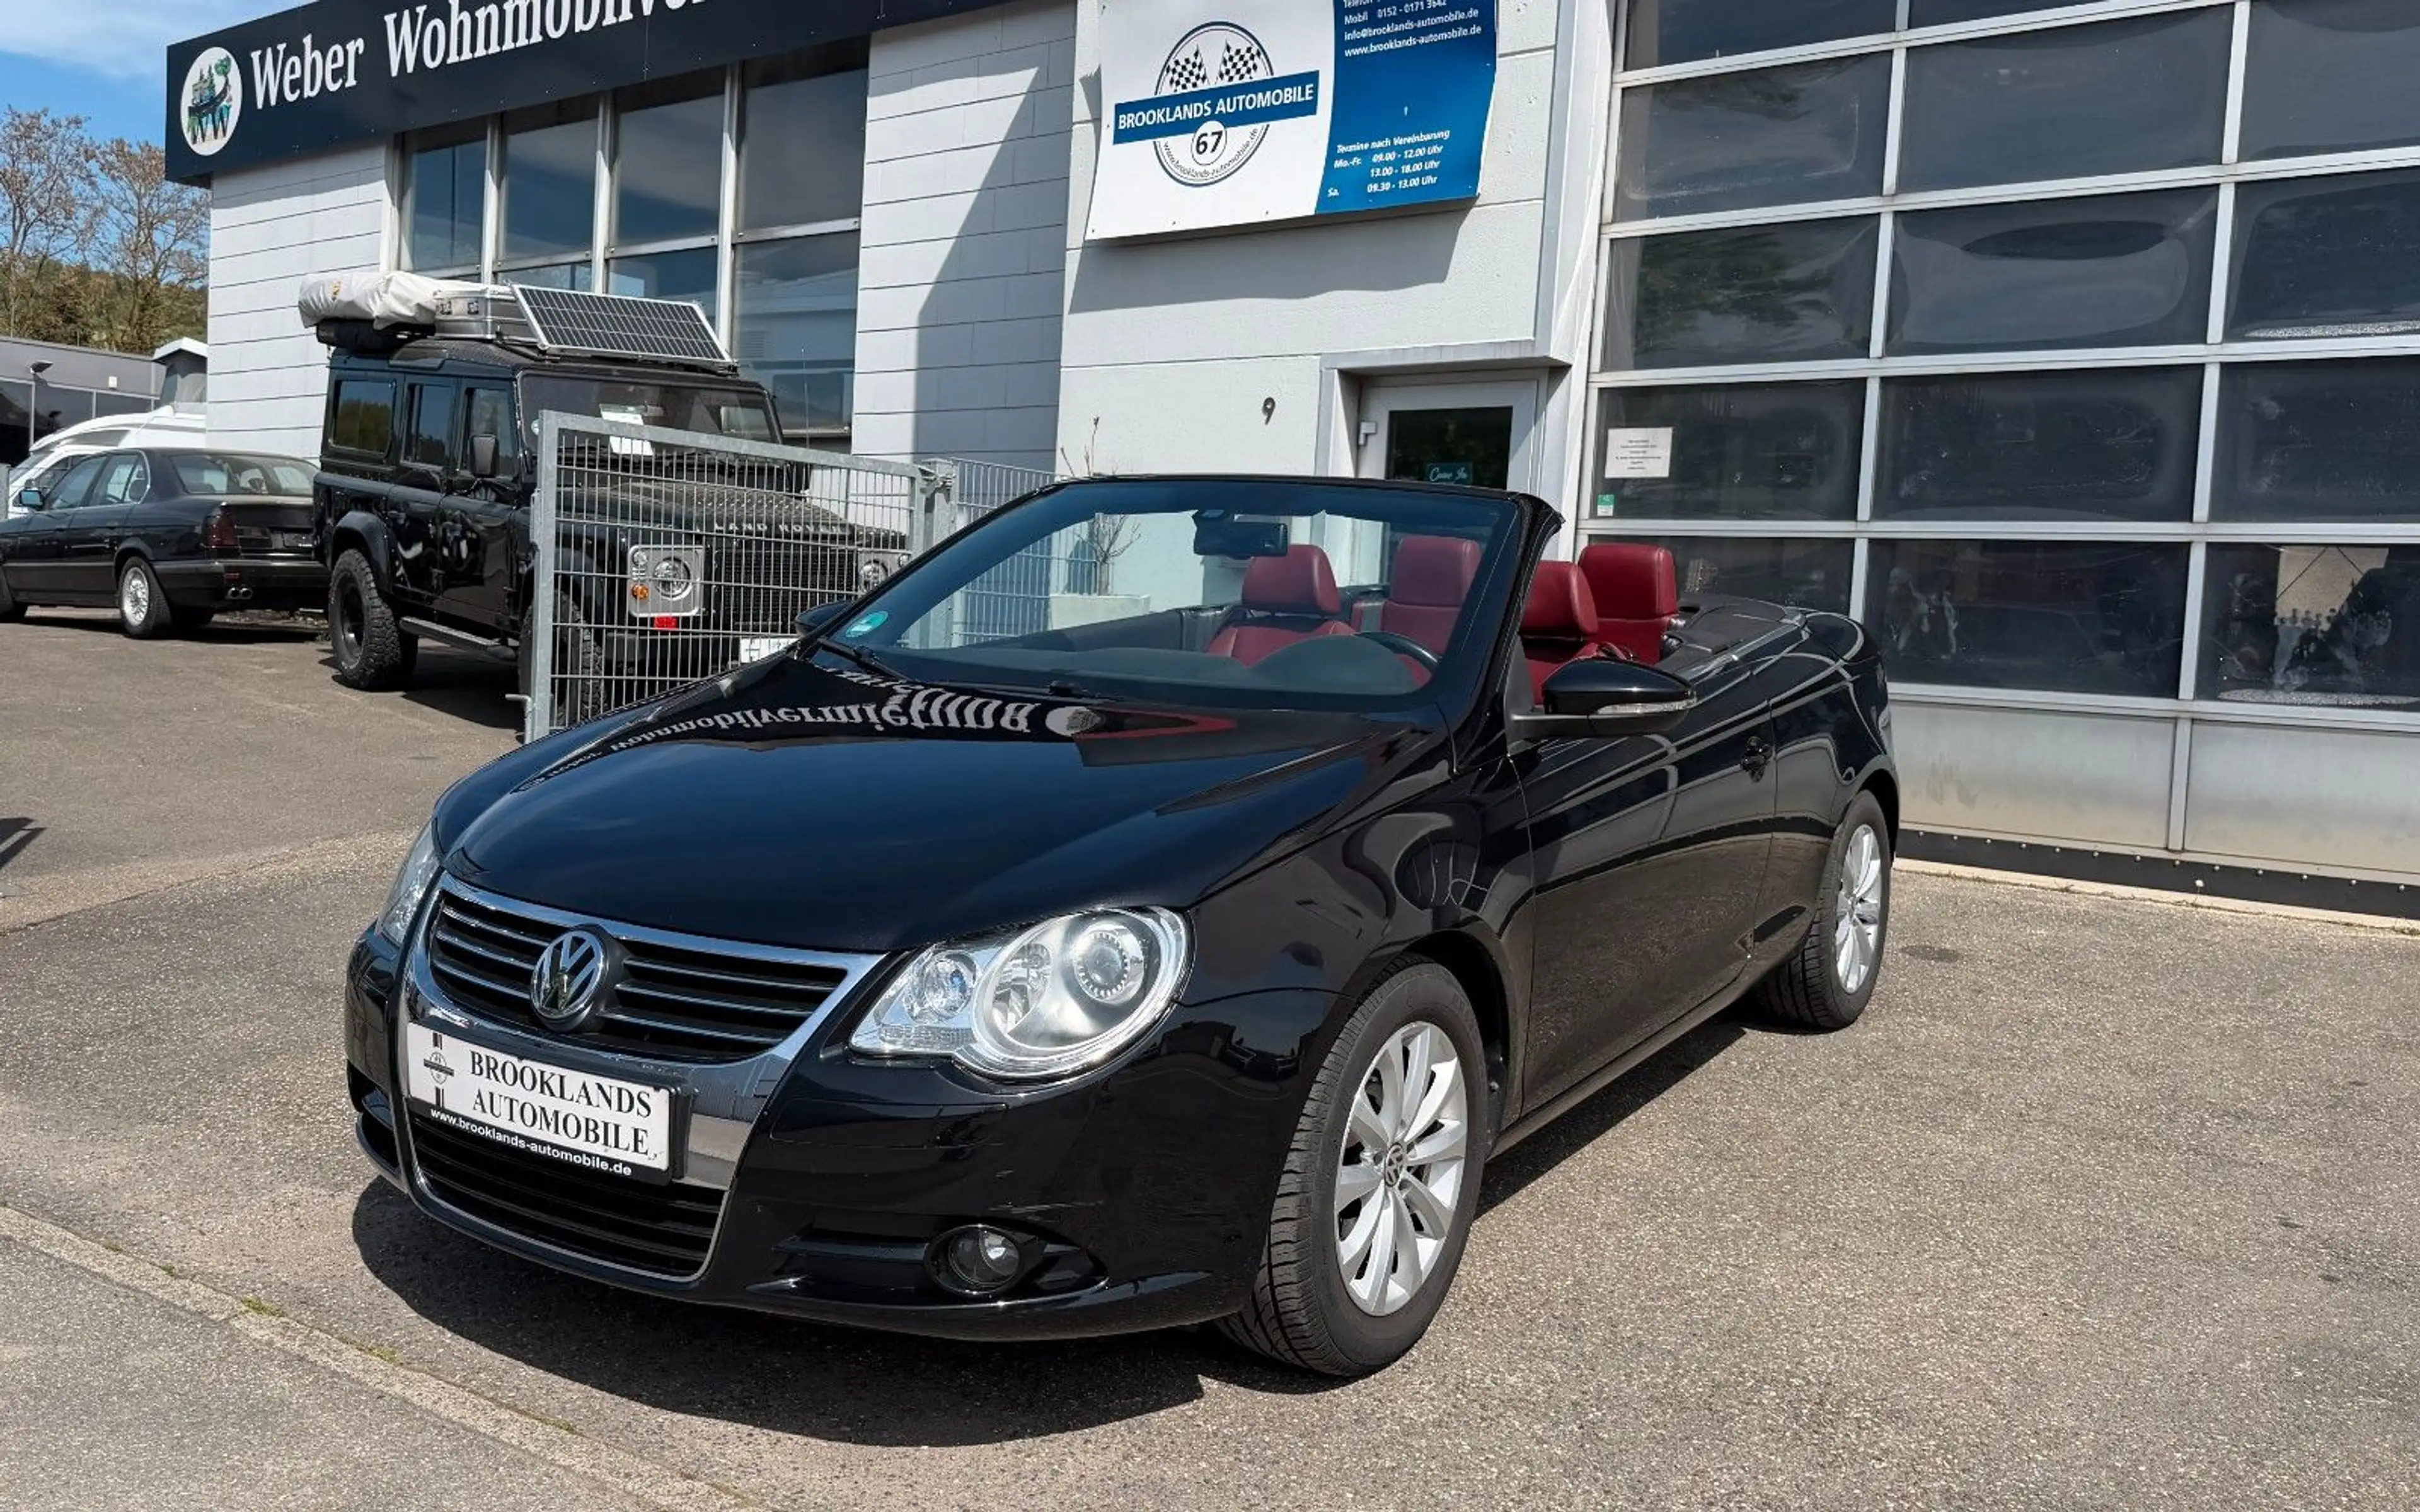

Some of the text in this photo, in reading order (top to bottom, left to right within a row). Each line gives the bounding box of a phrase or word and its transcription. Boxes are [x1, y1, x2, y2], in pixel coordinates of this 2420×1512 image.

[1344, 11, 1368, 25] Mobil
[1377, 6, 1398, 18] 0152
[1403, 2, 1424, 13] 0171
[1344, 8, 1479, 41] info@brooklands-automobile.de
[251, 0, 706, 110] Weber Wohnmob
[1344, 25, 1482, 57] www.brooklands-automobile.de
[1119, 83, 1314, 130] BROOKLANDS AUTOMOBILE
[1196, 130, 1223, 155] 67
[1337, 130, 1451, 154] Termine nach Vereinbarung
[1403, 147, 1426, 159] 12.00
[1427, 144, 1444, 155] Uhr
[1370, 166, 1393, 177] 13.00
[1424, 159, 1440, 169] Uhr
[1398, 177, 1419, 189] 13.00
[1421, 175, 1438, 185] Uhr
[1262, 397, 1276, 426] 9
[470, 1050, 652, 1119] BROOKLANDS
[473, 1089, 649, 1156] AUTOMOBILE
[431, 1108, 632, 1177] www.brooklands-automobile.de
